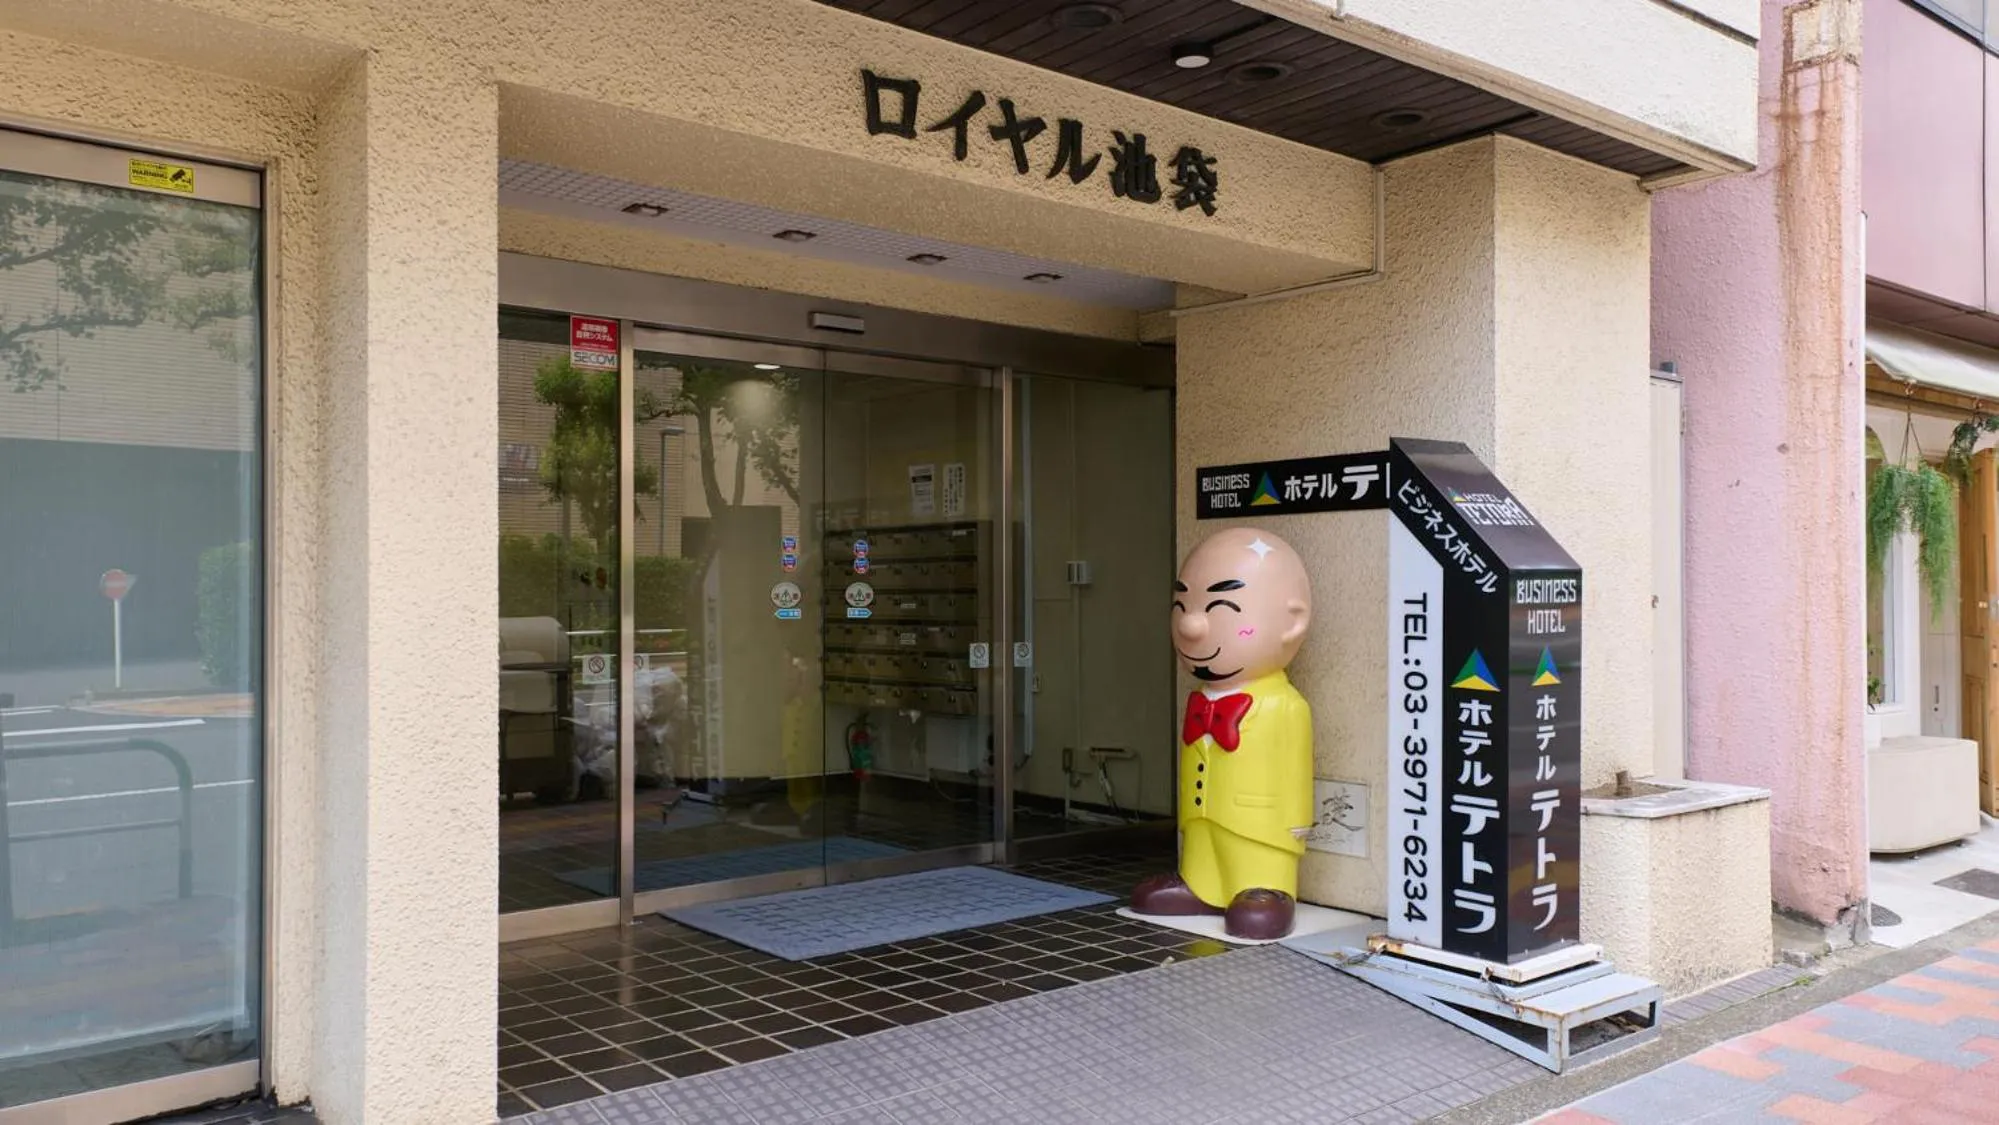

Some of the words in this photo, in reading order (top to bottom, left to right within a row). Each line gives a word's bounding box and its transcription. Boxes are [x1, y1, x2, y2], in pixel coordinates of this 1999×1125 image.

[861, 69, 1217, 217] ロイヤル池袋
[574, 352, 616, 366] SECOM
[1202, 473, 1250, 492] BUSINESS
[1211, 492, 1242, 509] HOTEL
[1463, 492, 1503, 503] HOTEL
[1398, 479, 1499, 593] ビジネスホテル
[1517, 579, 1577, 604] BUSINESS
[1528, 609, 1566, 634] HOTEL
